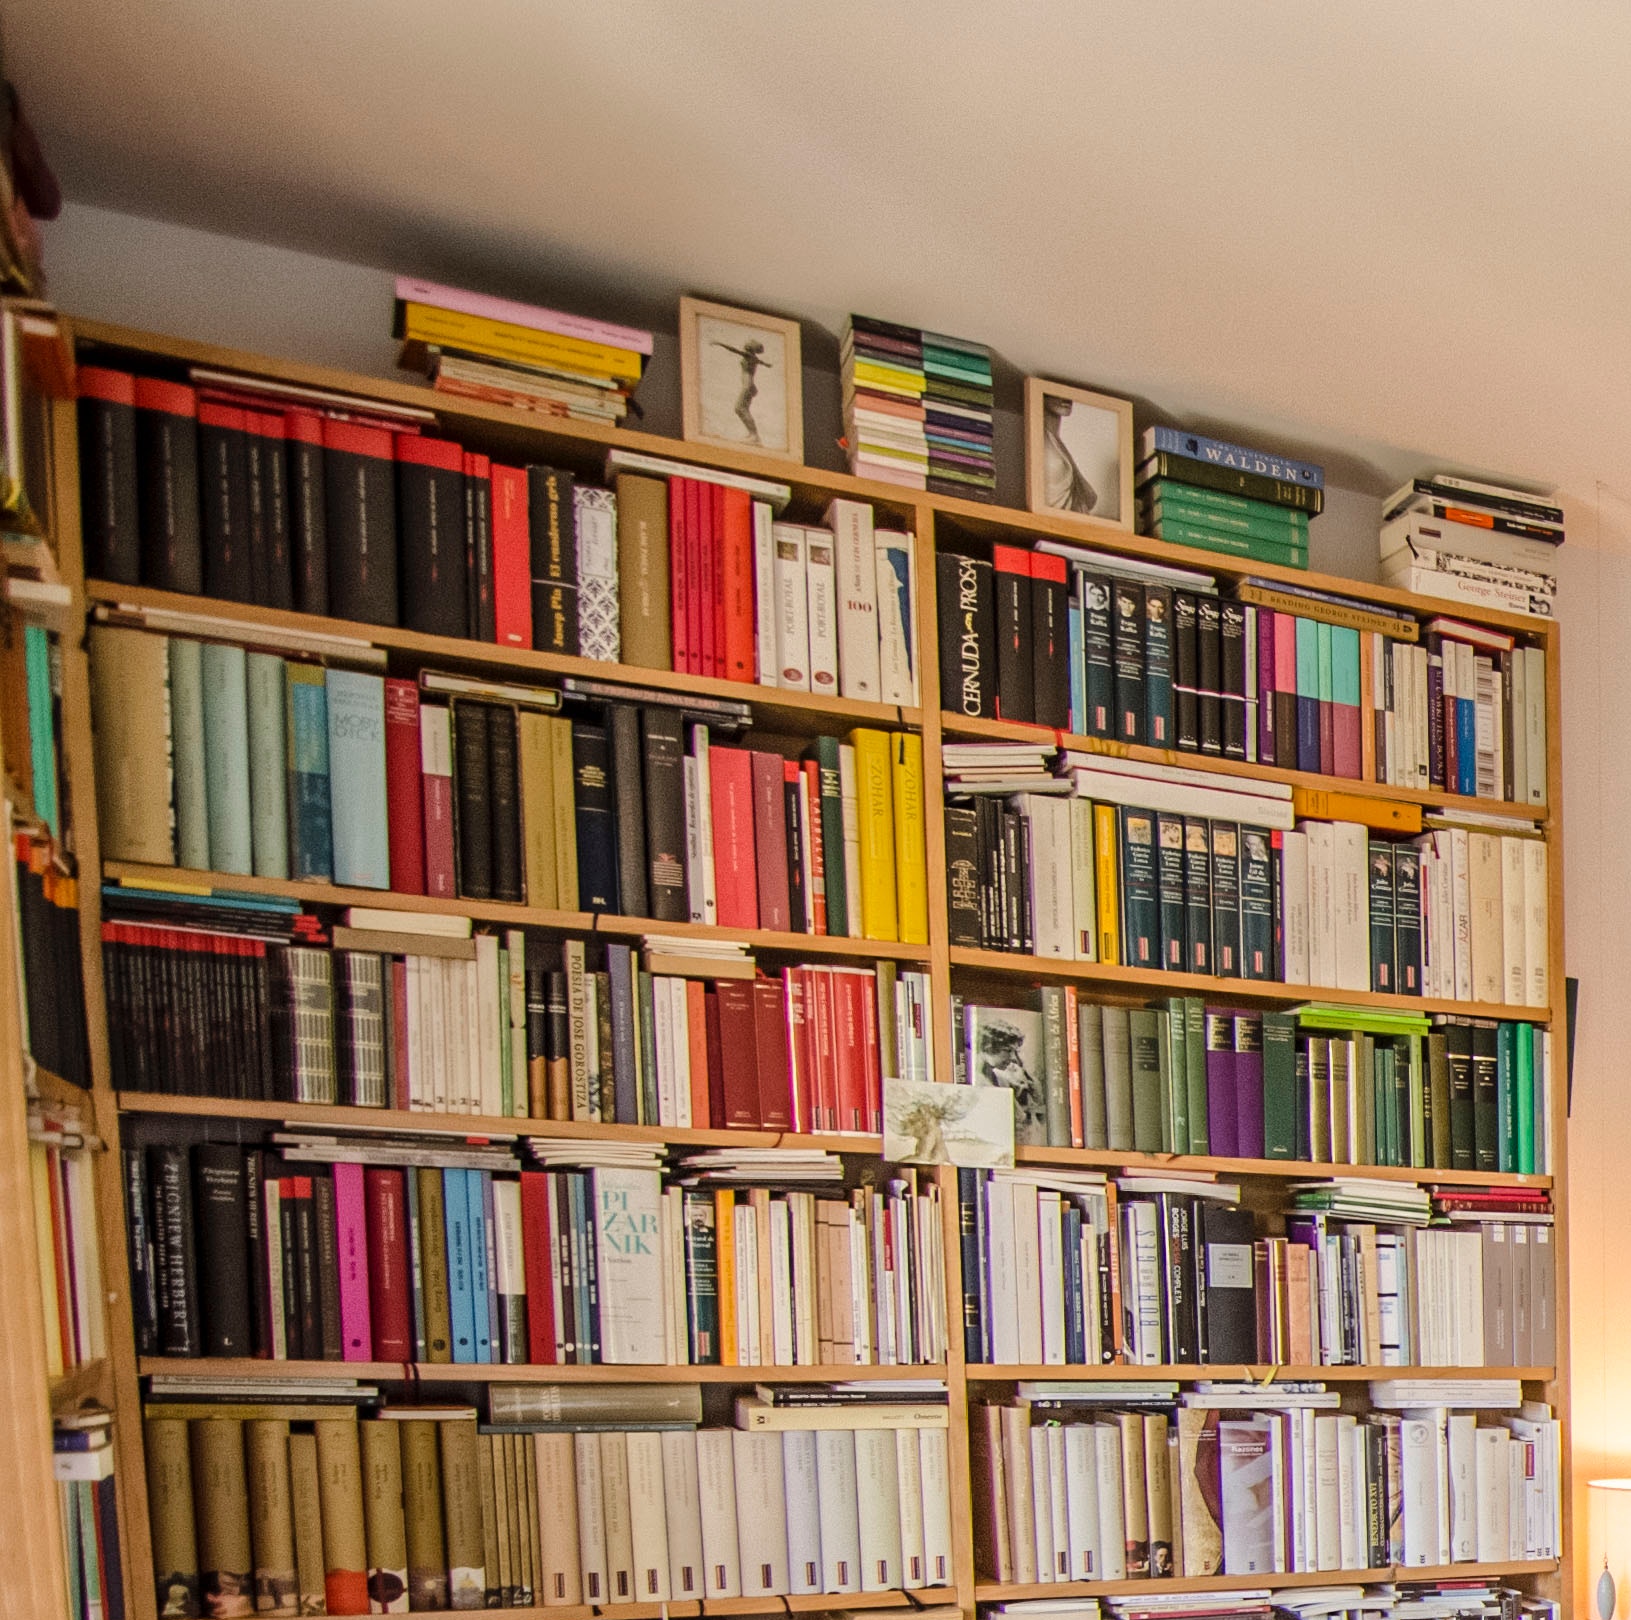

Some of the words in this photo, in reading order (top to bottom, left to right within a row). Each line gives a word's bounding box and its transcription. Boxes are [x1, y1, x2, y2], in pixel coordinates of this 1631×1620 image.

[1205, 447, 1297, 481] WALDEN
[959, 558, 979, 612] PROSA
[1457, 580, 1491, 596] George
[1495, 589, 1526, 603] Steiner
[847, 600, 872, 613] 100
[1270, 596, 1311, 613] READING
[1313, 604, 1348, 620] GEORGE
[1351, 612, 1388, 628] STEINER
[962, 633, 981, 717] CERNUDA
[872, 761, 884, 818] ZOHAR
[903, 765, 917, 820] ZOHAR
[573, 999, 584, 1012] DE
[574, 1043, 587, 1109] GOROSTIZA
[164, 1164, 183, 1248] ZBIGNIEW
[1172, 1207, 1180, 1238] BORGES
[1180, 1207, 1188, 1232] JORGE
[603, 1213, 658, 1234] ZAR
[605, 1233, 652, 1255] NIK
[1181, 1234, 1189, 1250] LUIS
[169, 1253, 187, 1330] HERBERT
[1174, 1265, 1182, 1304] COMPLETA
[1370, 1482, 1378, 1498] XVI
[1371, 1499, 1379, 1547] BENEDICTO
